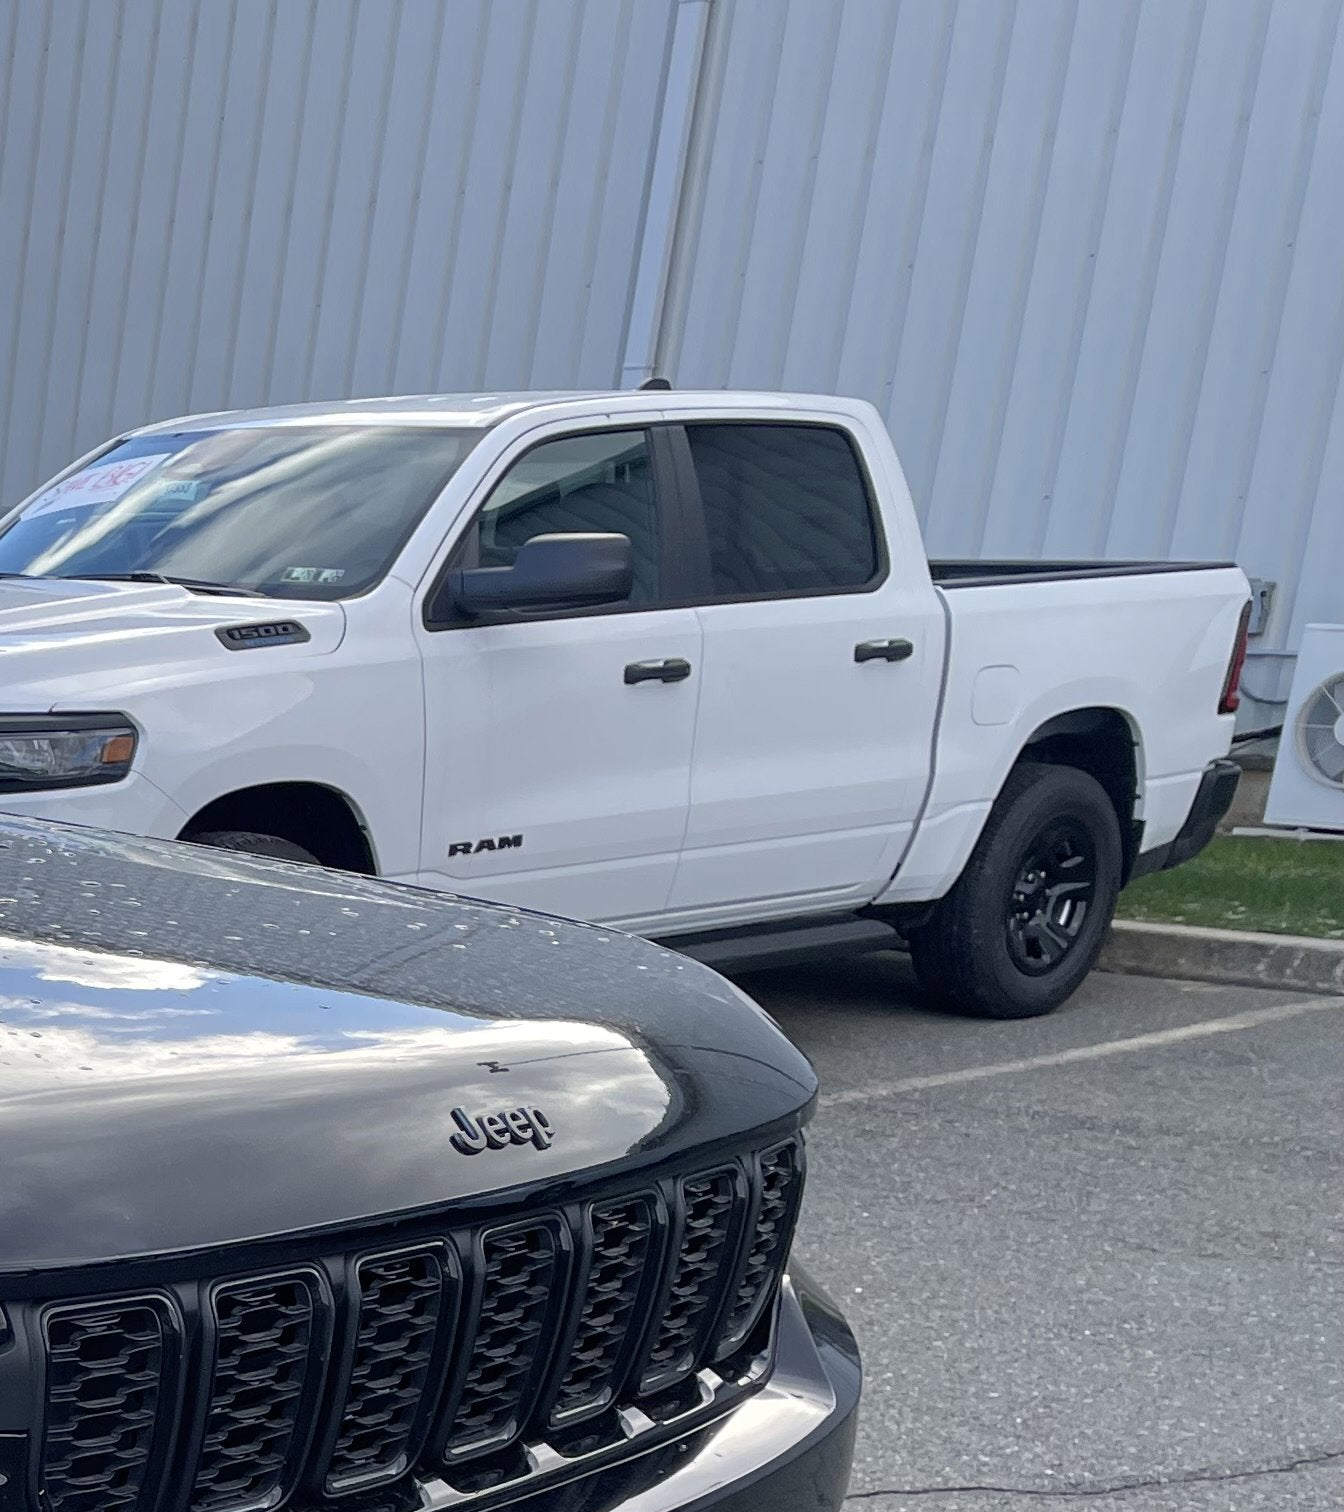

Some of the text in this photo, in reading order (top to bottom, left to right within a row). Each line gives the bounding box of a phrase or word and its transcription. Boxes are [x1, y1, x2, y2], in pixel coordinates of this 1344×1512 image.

[228, 623, 295, 640] 1500
[448, 834, 523, 857] RAM
[449, 1105, 555, 1155] Jeep
